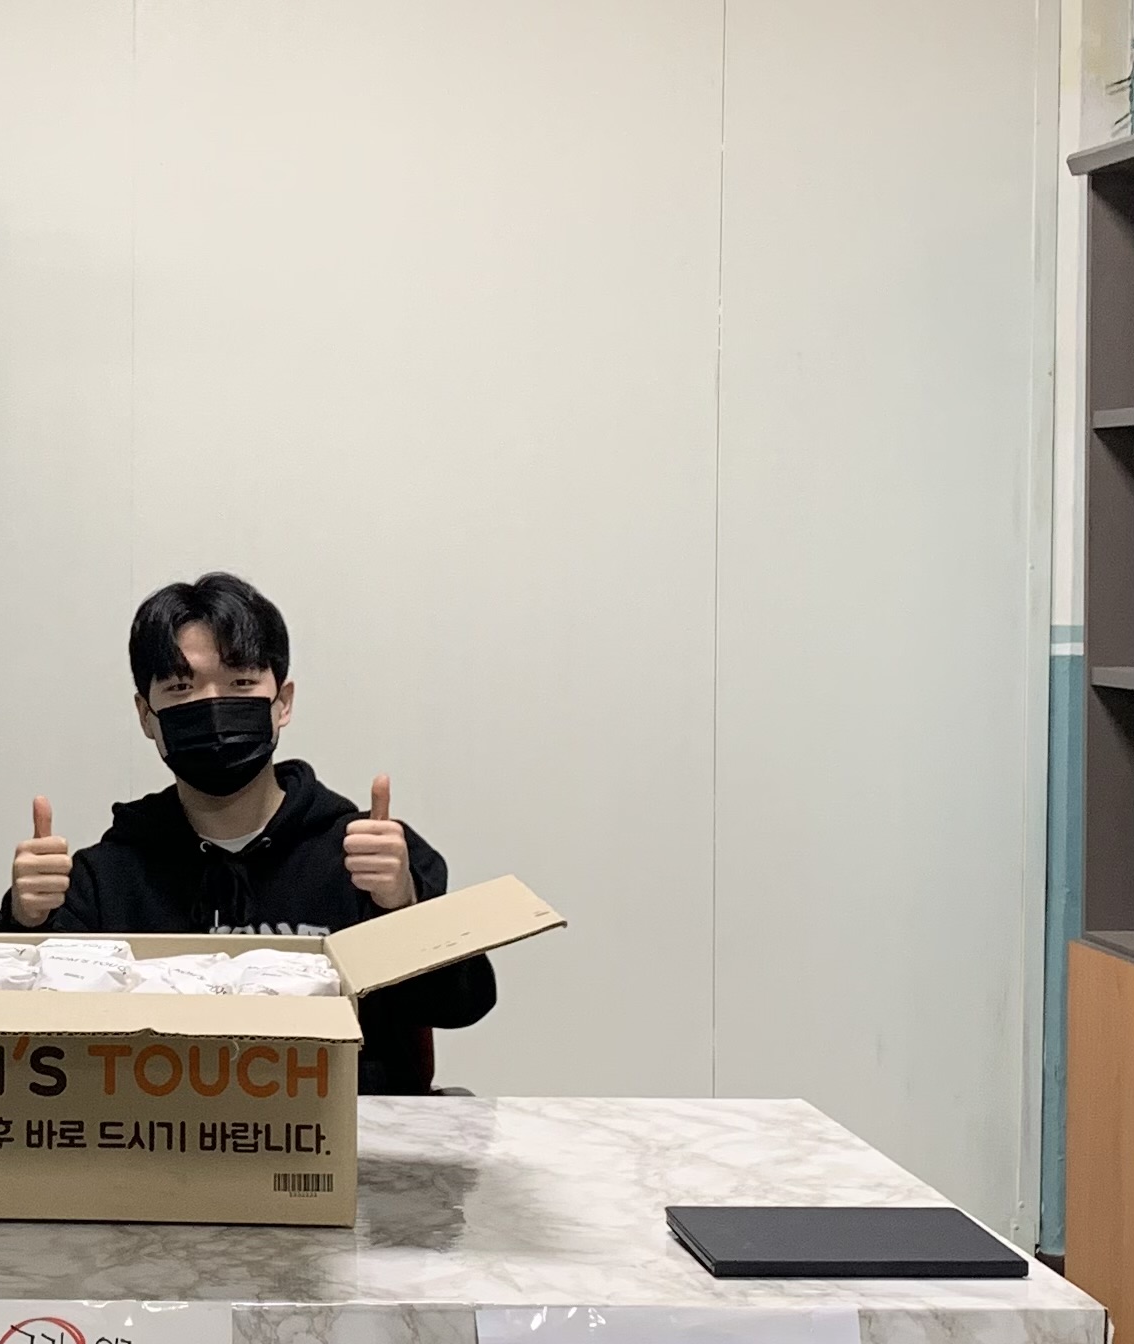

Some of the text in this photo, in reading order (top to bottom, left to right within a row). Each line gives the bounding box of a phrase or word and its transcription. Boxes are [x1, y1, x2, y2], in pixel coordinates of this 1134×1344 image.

[88, 1043, 329, 1099] TOUCH
[25, 1119, 87, 1151] 바로
[97, 1120, 187, 1153] 드시기
[199, 1121, 332, 1156] 바랍니다.
